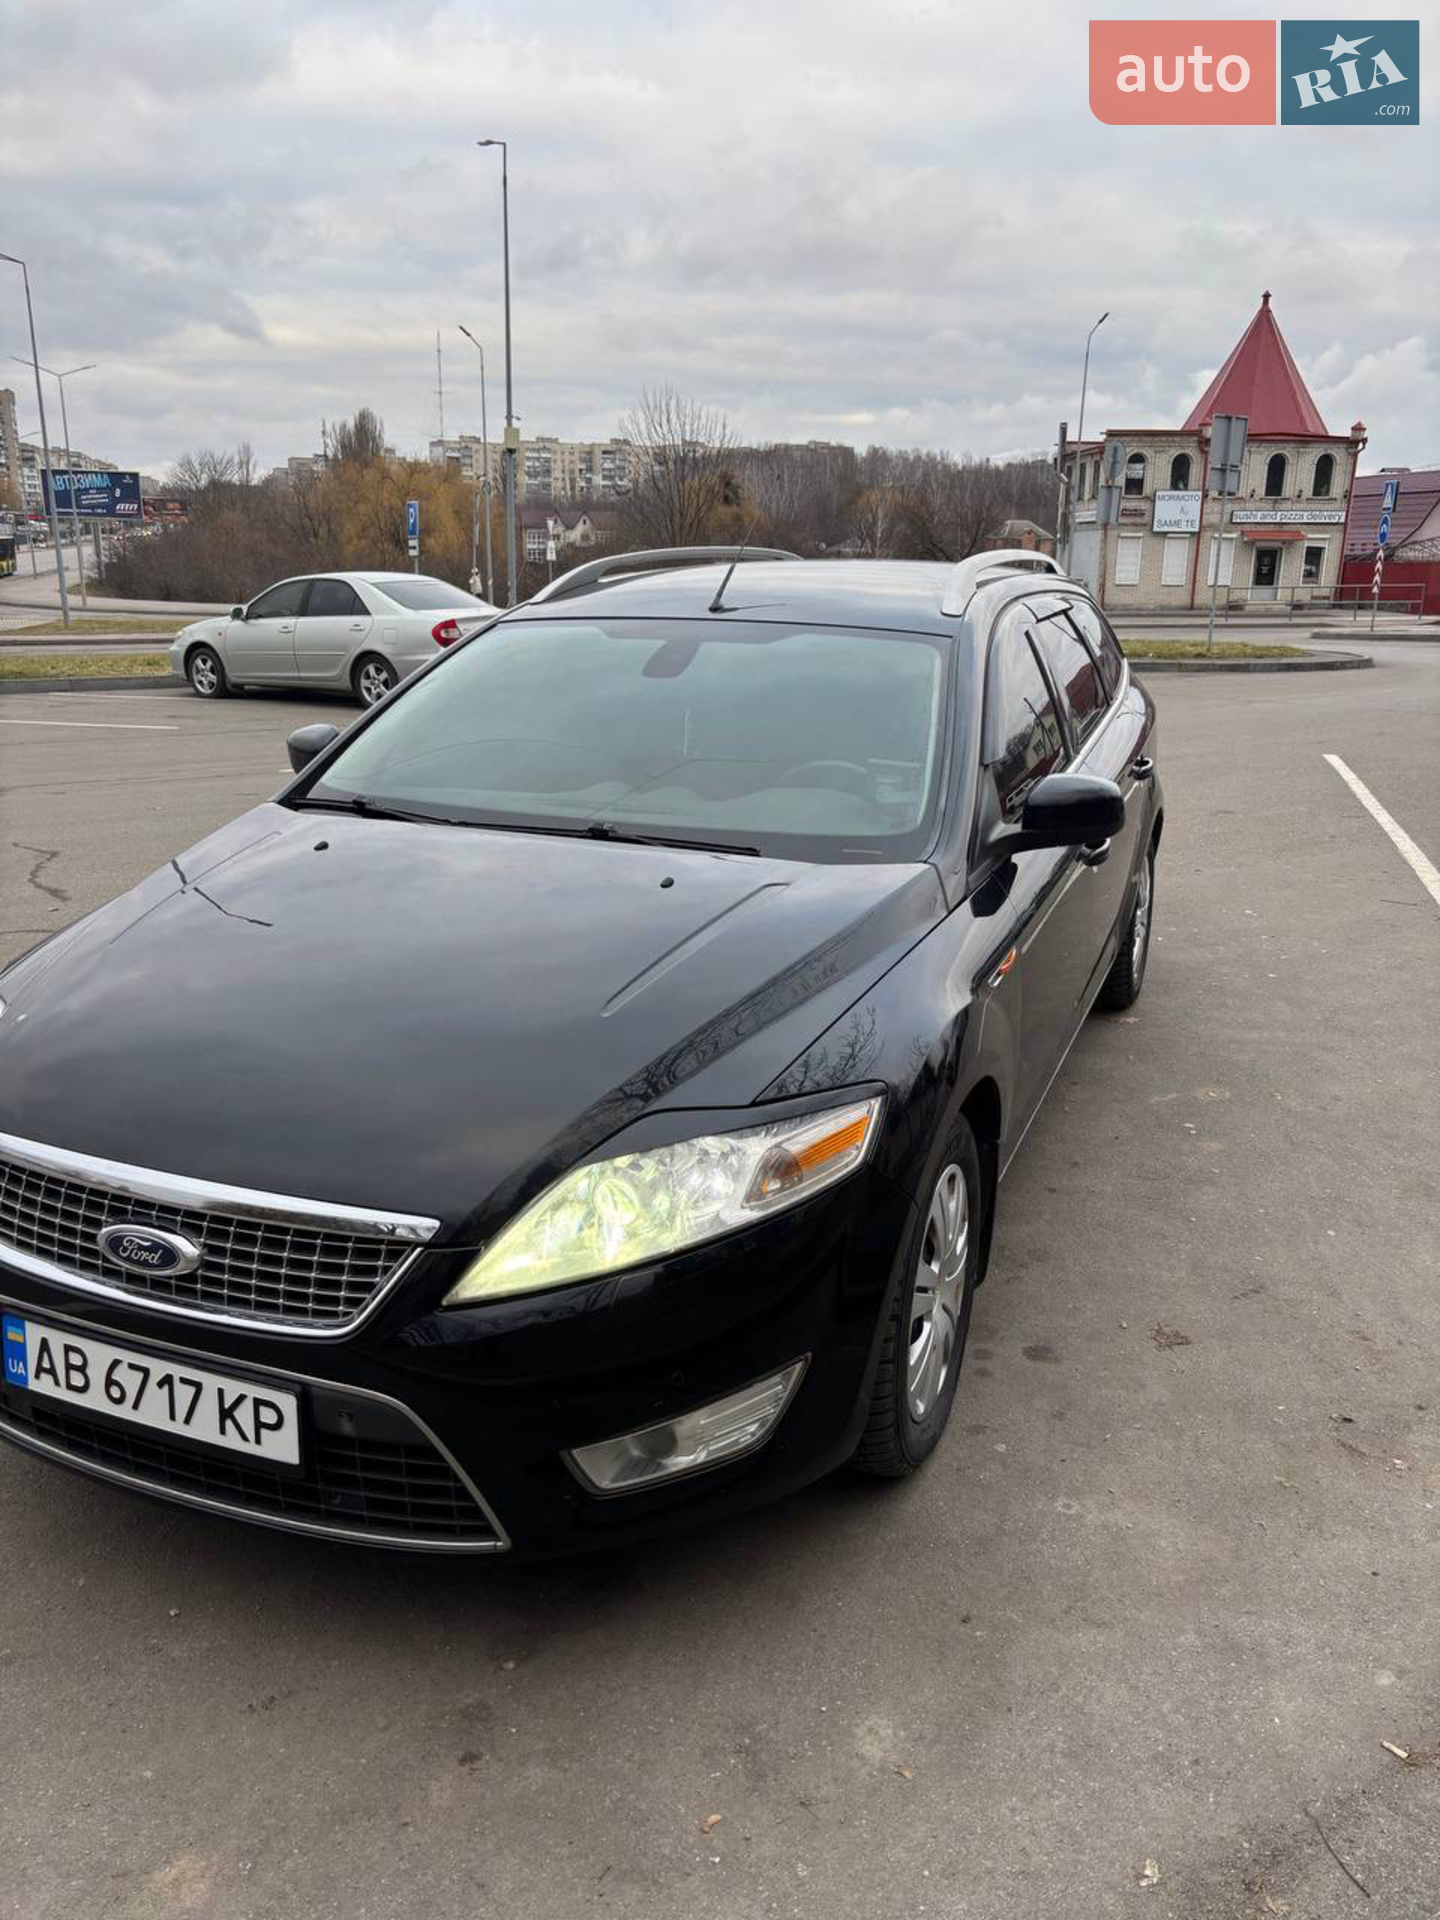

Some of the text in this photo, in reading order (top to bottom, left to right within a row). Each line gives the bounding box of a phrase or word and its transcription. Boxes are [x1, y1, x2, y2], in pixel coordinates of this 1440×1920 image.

[1186, 519, 1197, 528] TE
[1233, 511, 1343, 522] sushi and pizza delivery
[119, 1235, 162, 1266] Ford
[8, 1358, 26, 1376] UA
[34, 1336, 285, 1445] AB 6717 KP
